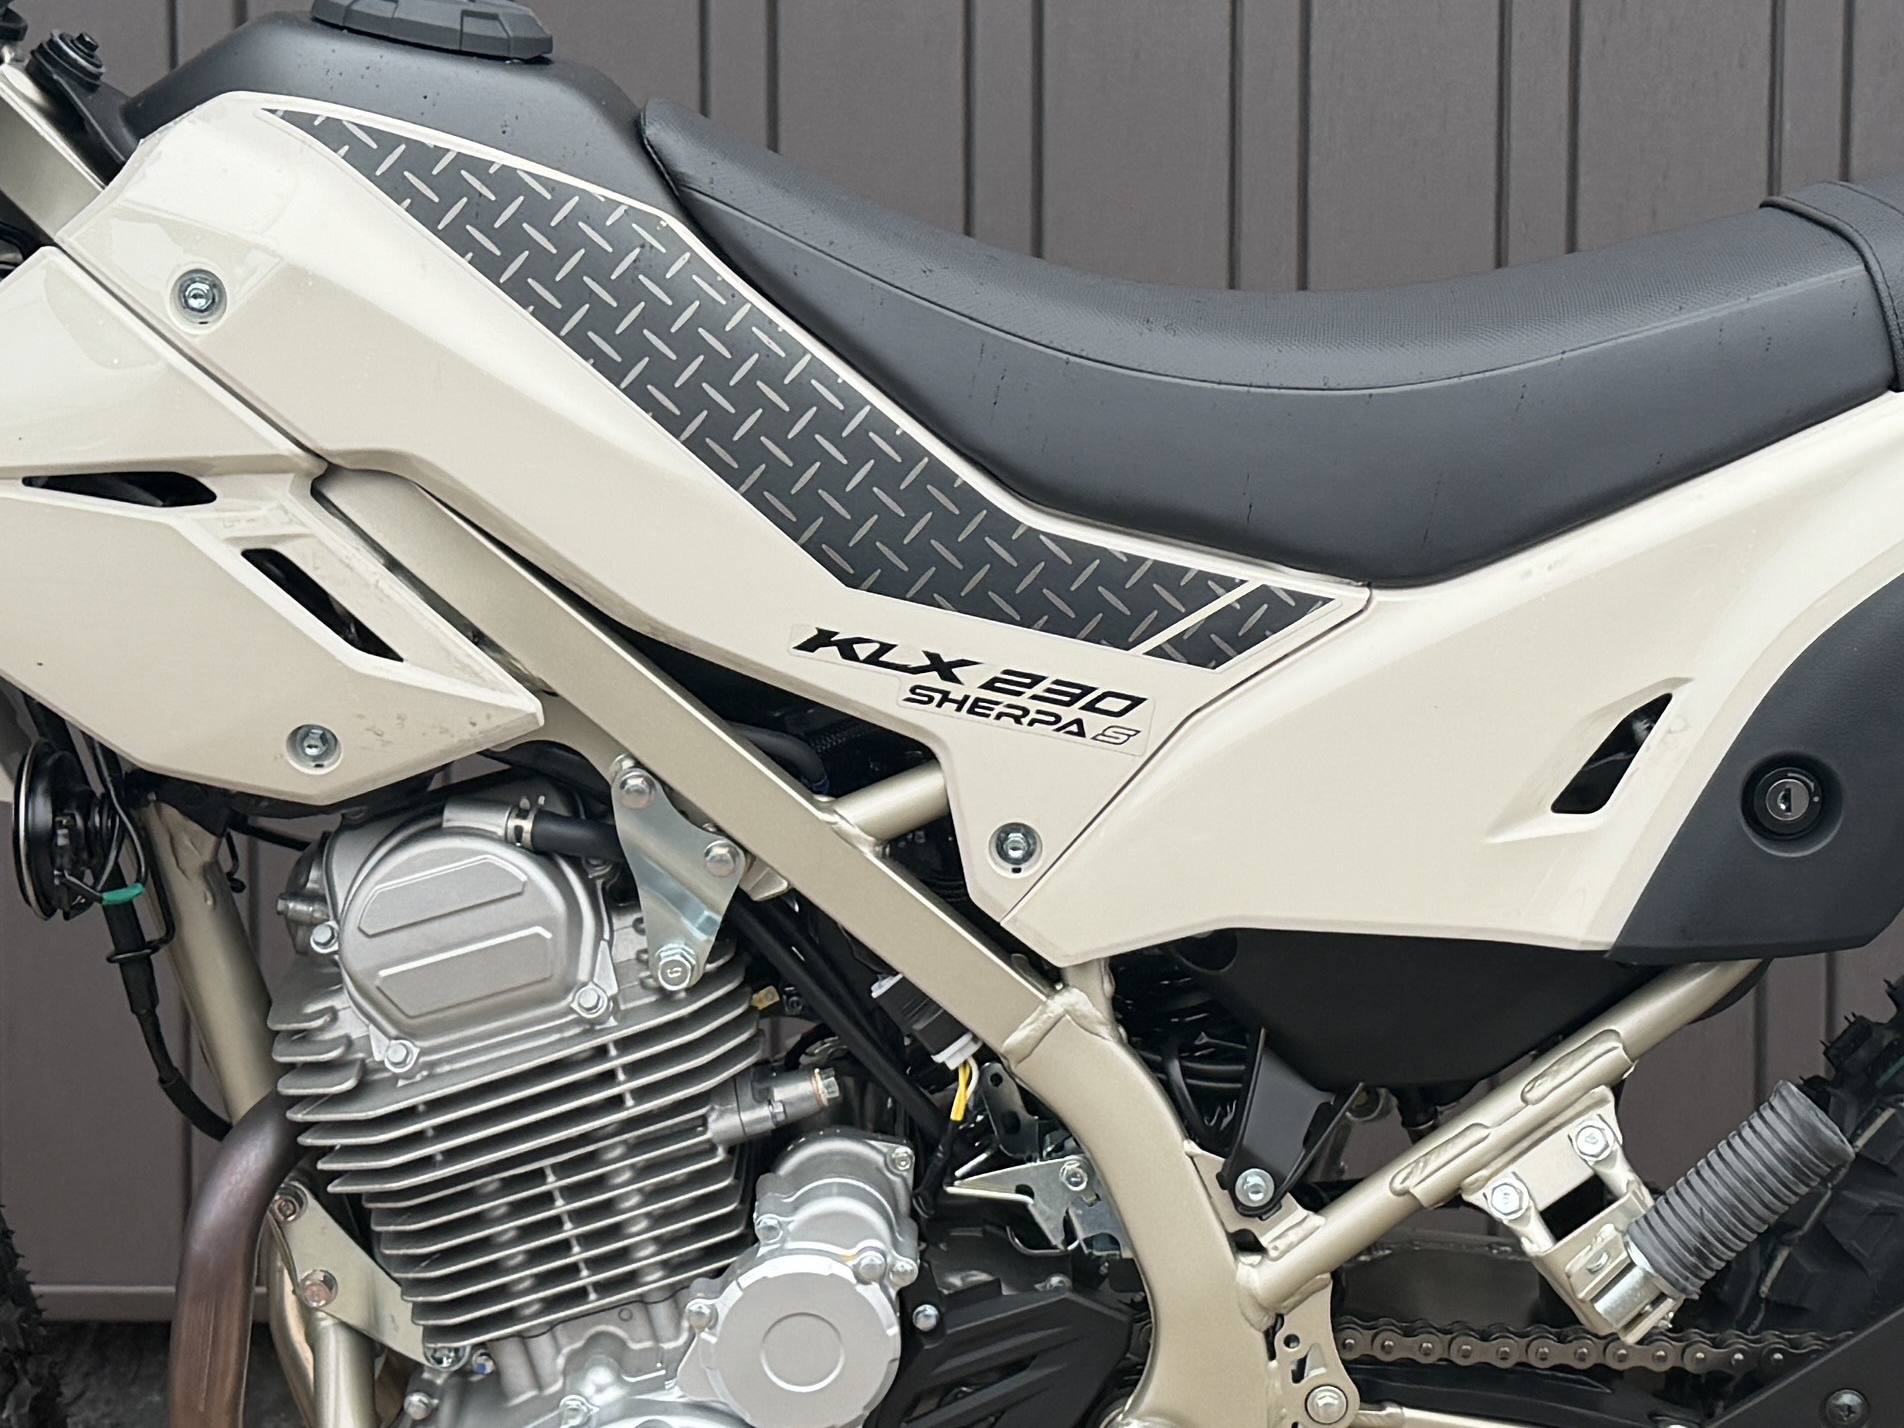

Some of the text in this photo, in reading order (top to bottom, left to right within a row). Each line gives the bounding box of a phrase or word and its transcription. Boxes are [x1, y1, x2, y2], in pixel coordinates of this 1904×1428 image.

[795, 627, 1149, 718] KLX 230
[901, 683, 1088, 739] SHERPA
